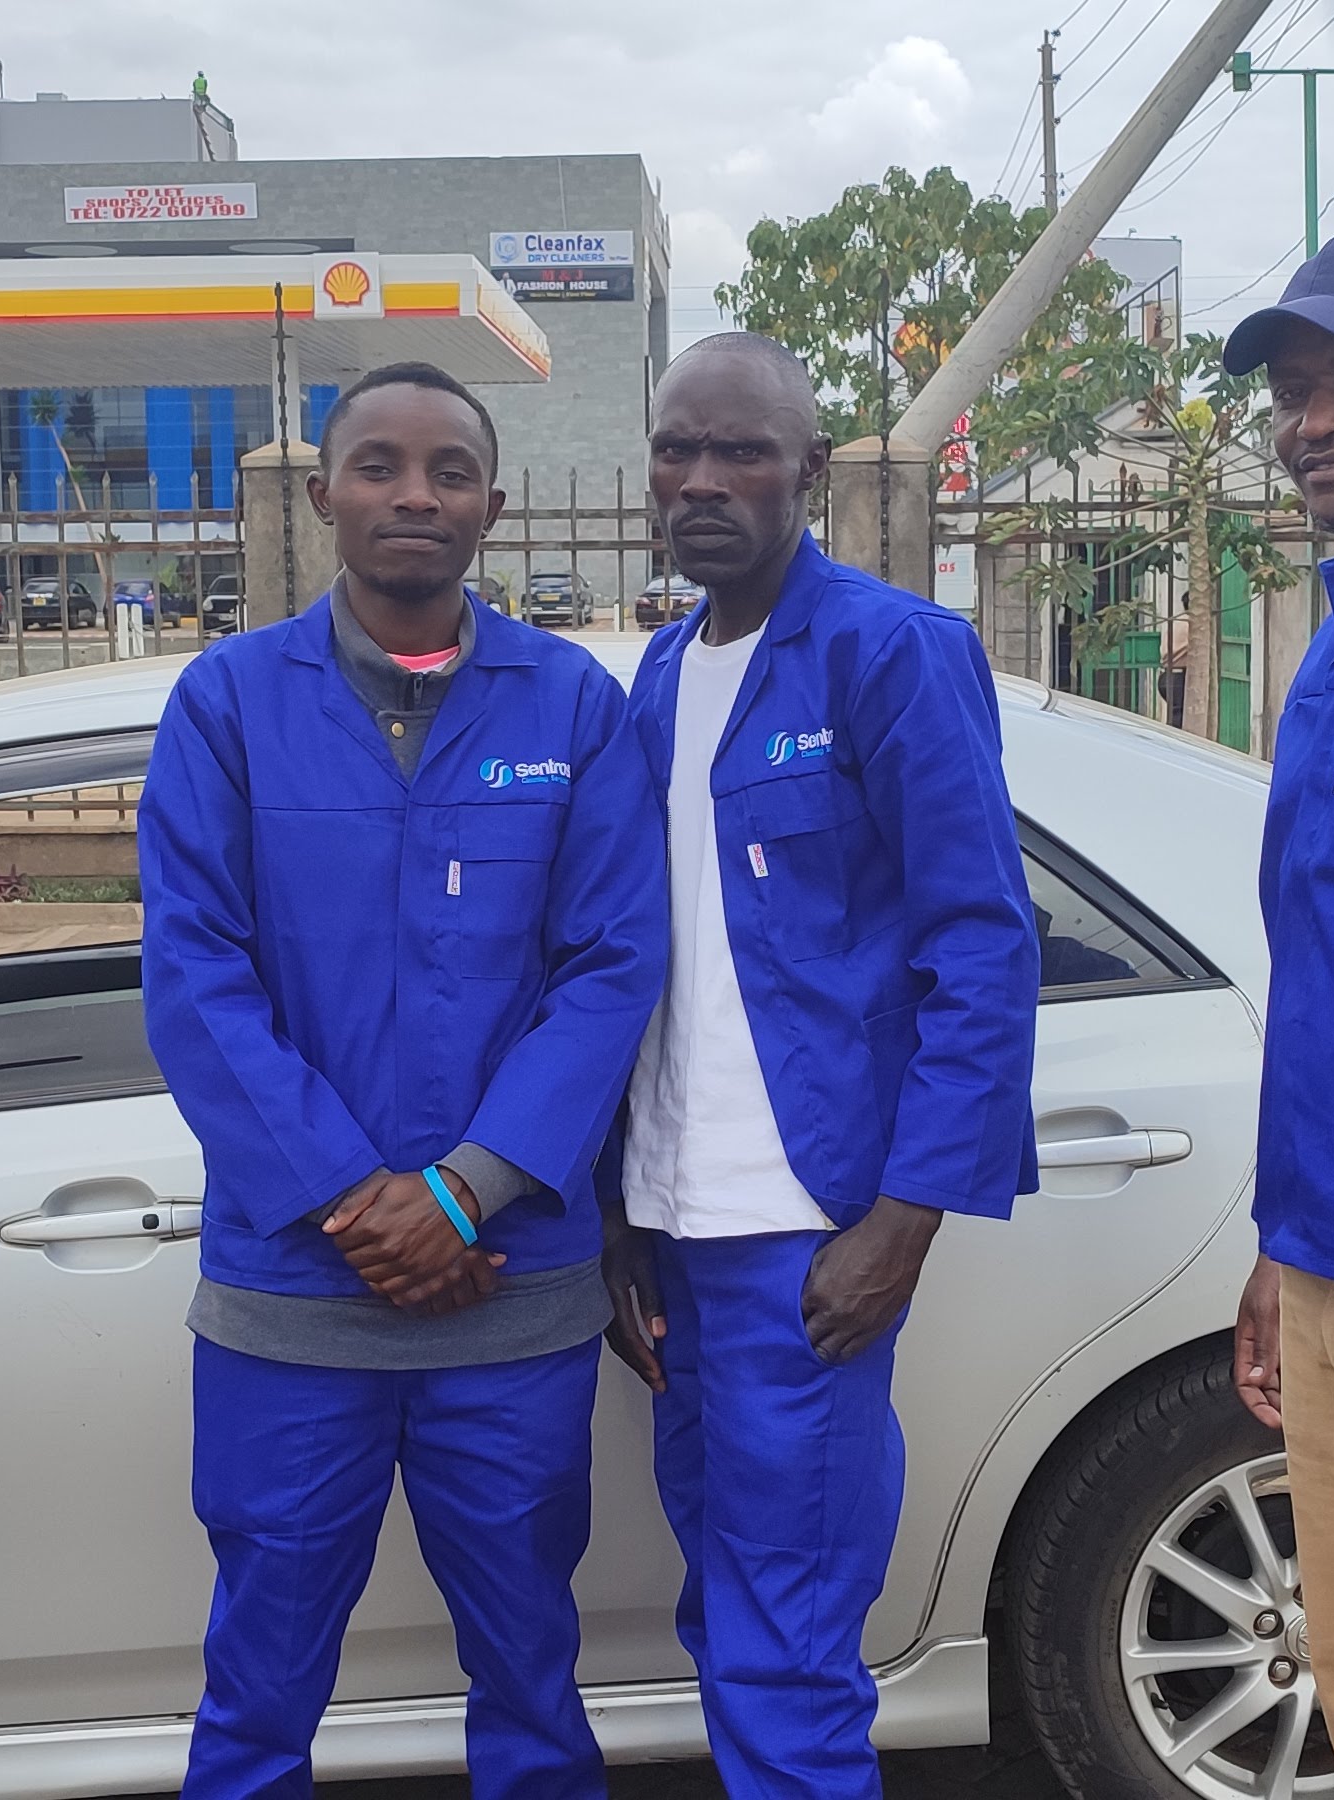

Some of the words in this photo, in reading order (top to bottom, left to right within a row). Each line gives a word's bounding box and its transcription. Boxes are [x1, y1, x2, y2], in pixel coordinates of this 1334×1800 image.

[124, 188, 148, 198] TO
[154, 187, 185, 197] LET
[86, 198, 142, 208] SHOPS
[158, 195, 224, 206] OFFICES
[70, 208, 108, 220] TEL:
[113, 206, 162, 219] 0722
[167, 205, 204, 217] 607
[207, 203, 246, 216] 199
[525, 234, 605, 251] Cleanfax
[527, 254, 549, 263] DRY
[550, 253, 605, 262] CLEANERS
[517, 281, 565, 291] FASHION
[569, 281, 609, 290] HOUSE
